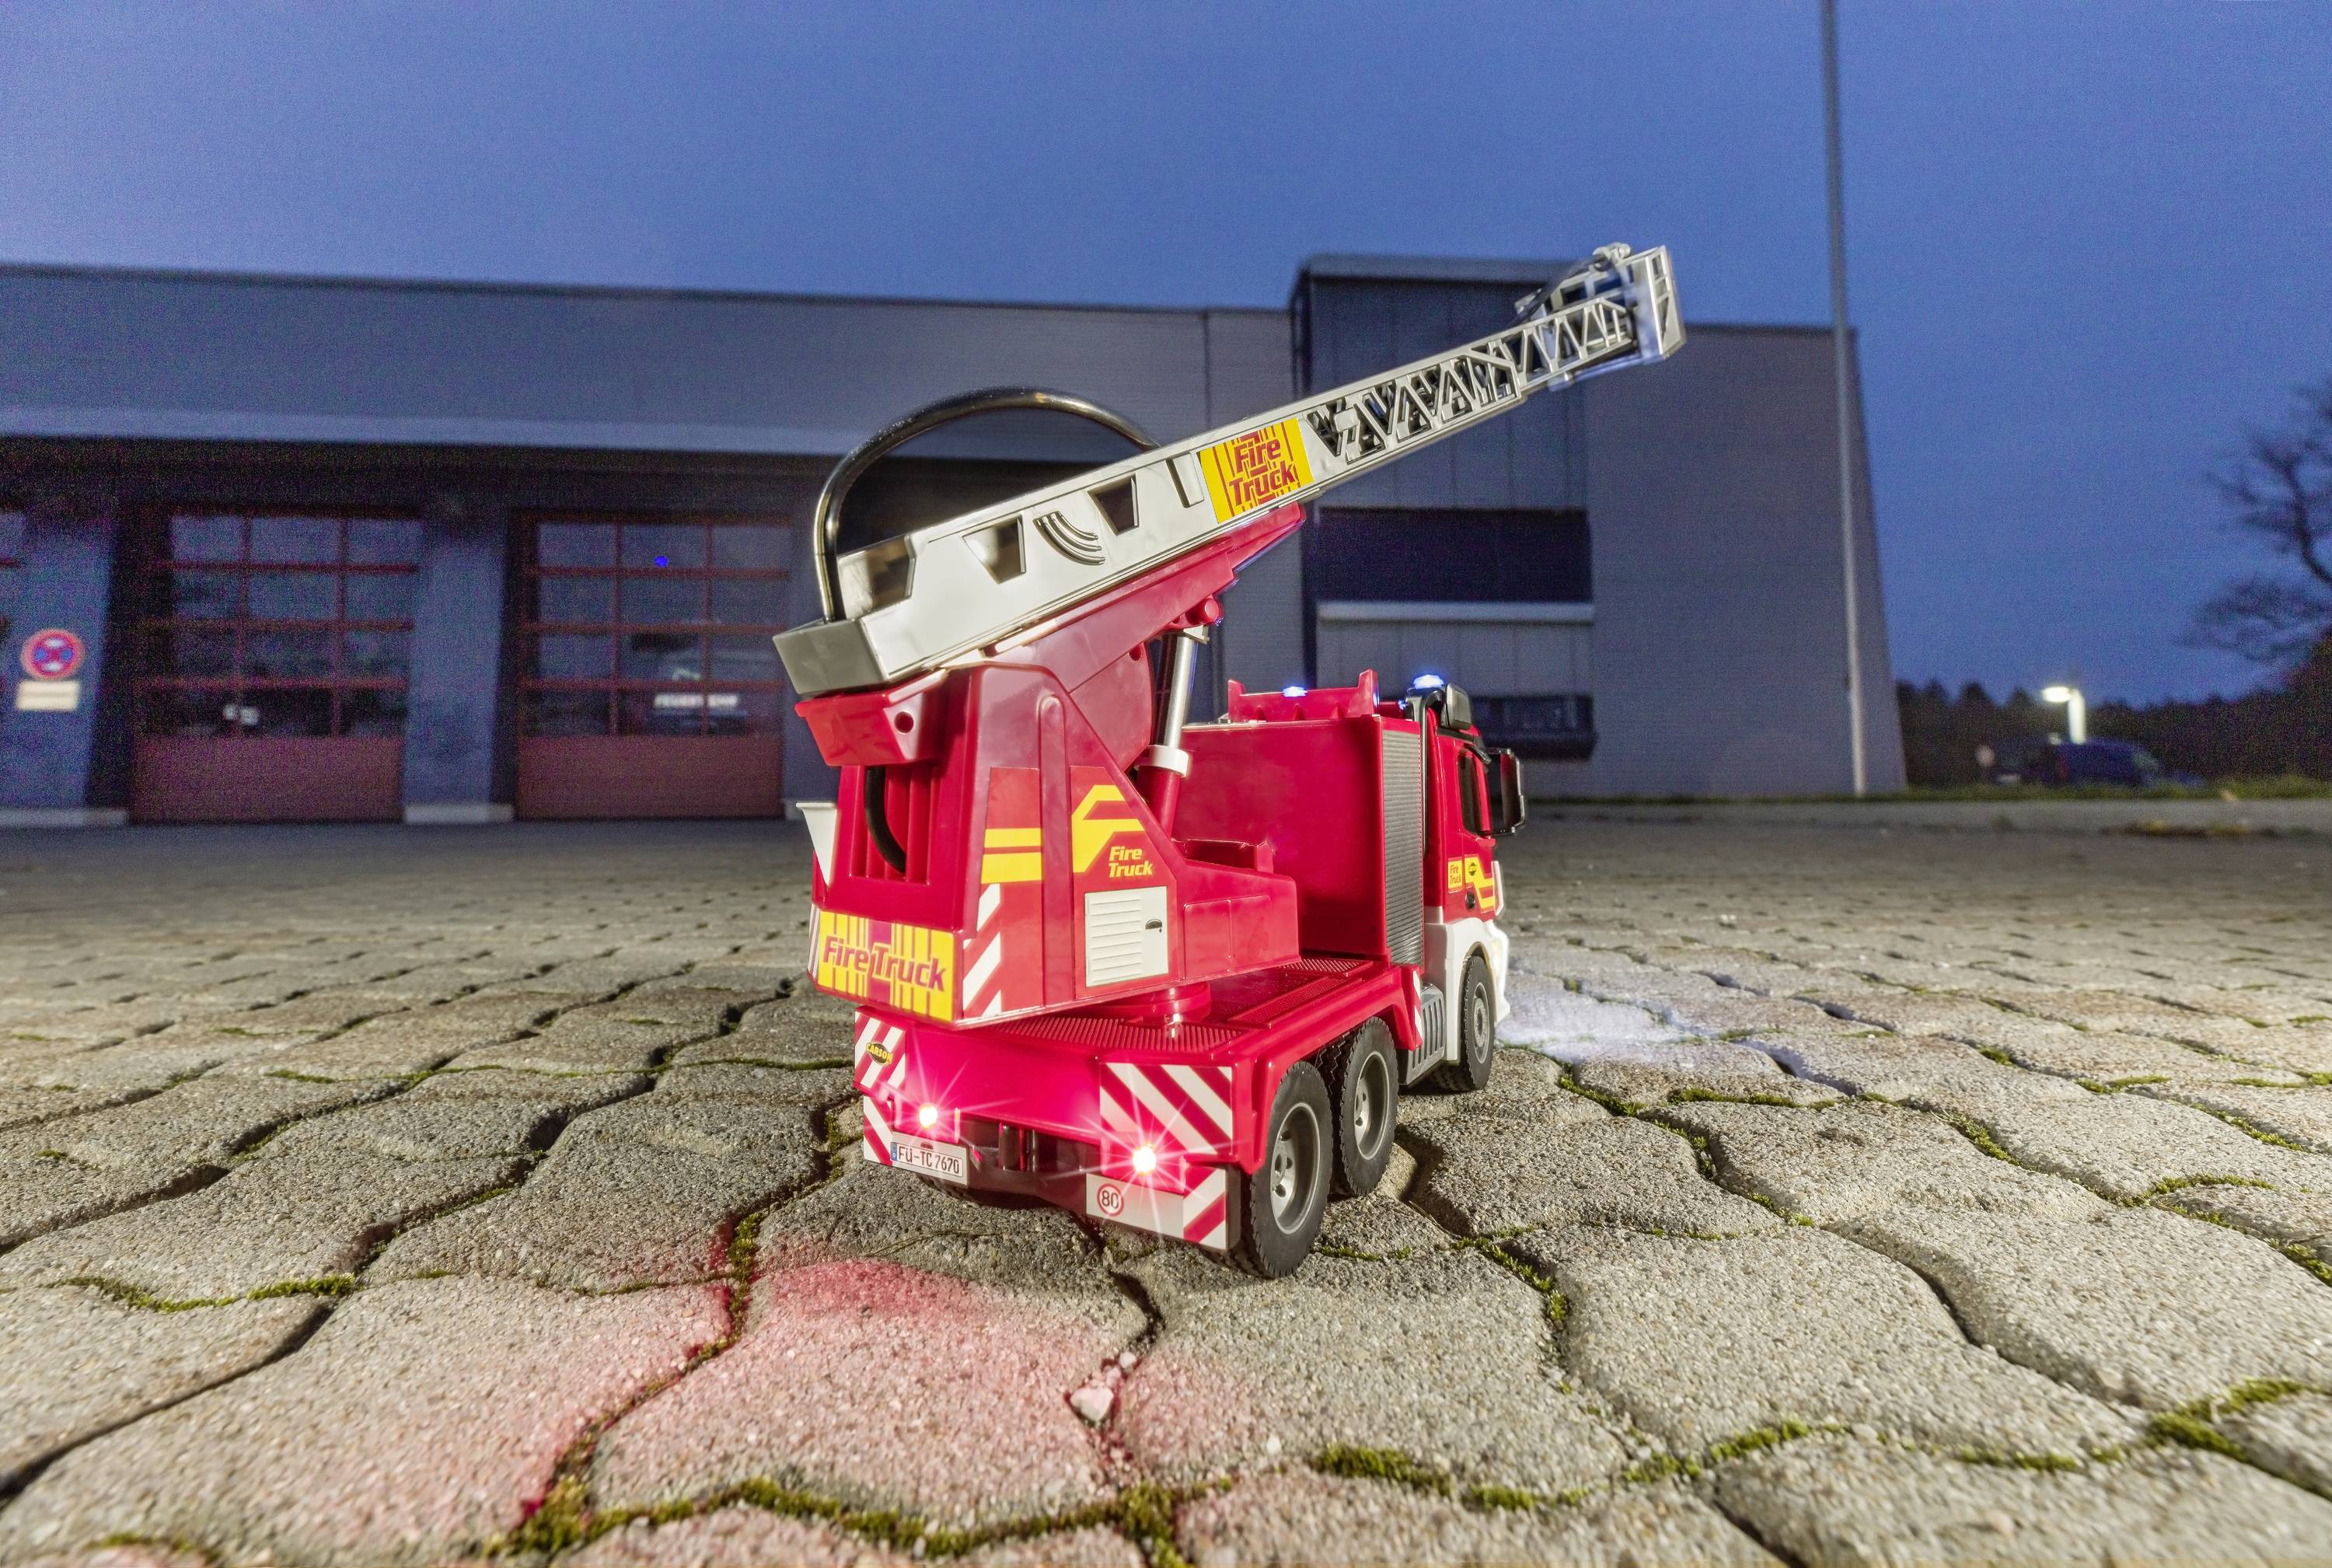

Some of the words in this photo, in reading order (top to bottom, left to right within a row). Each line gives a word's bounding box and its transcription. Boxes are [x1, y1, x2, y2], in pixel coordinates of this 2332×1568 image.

[1234, 438, 1282, 474] Fire
[1228, 459, 1297, 507] Truck
[1108, 845, 1143, 862] Fire
[1108, 860, 1154, 878] Truck
[1450, 864, 1459, 874] Fire
[822, 934, 871, 973] Fire
[870, 944, 947, 992] Truck
[866, 1042, 893, 1063] CARSON
[898, 1145, 933, 1168] FÜ-TC
[934, 1154, 960, 1175] 7670
[1101, 1189, 1119, 1210] 80
